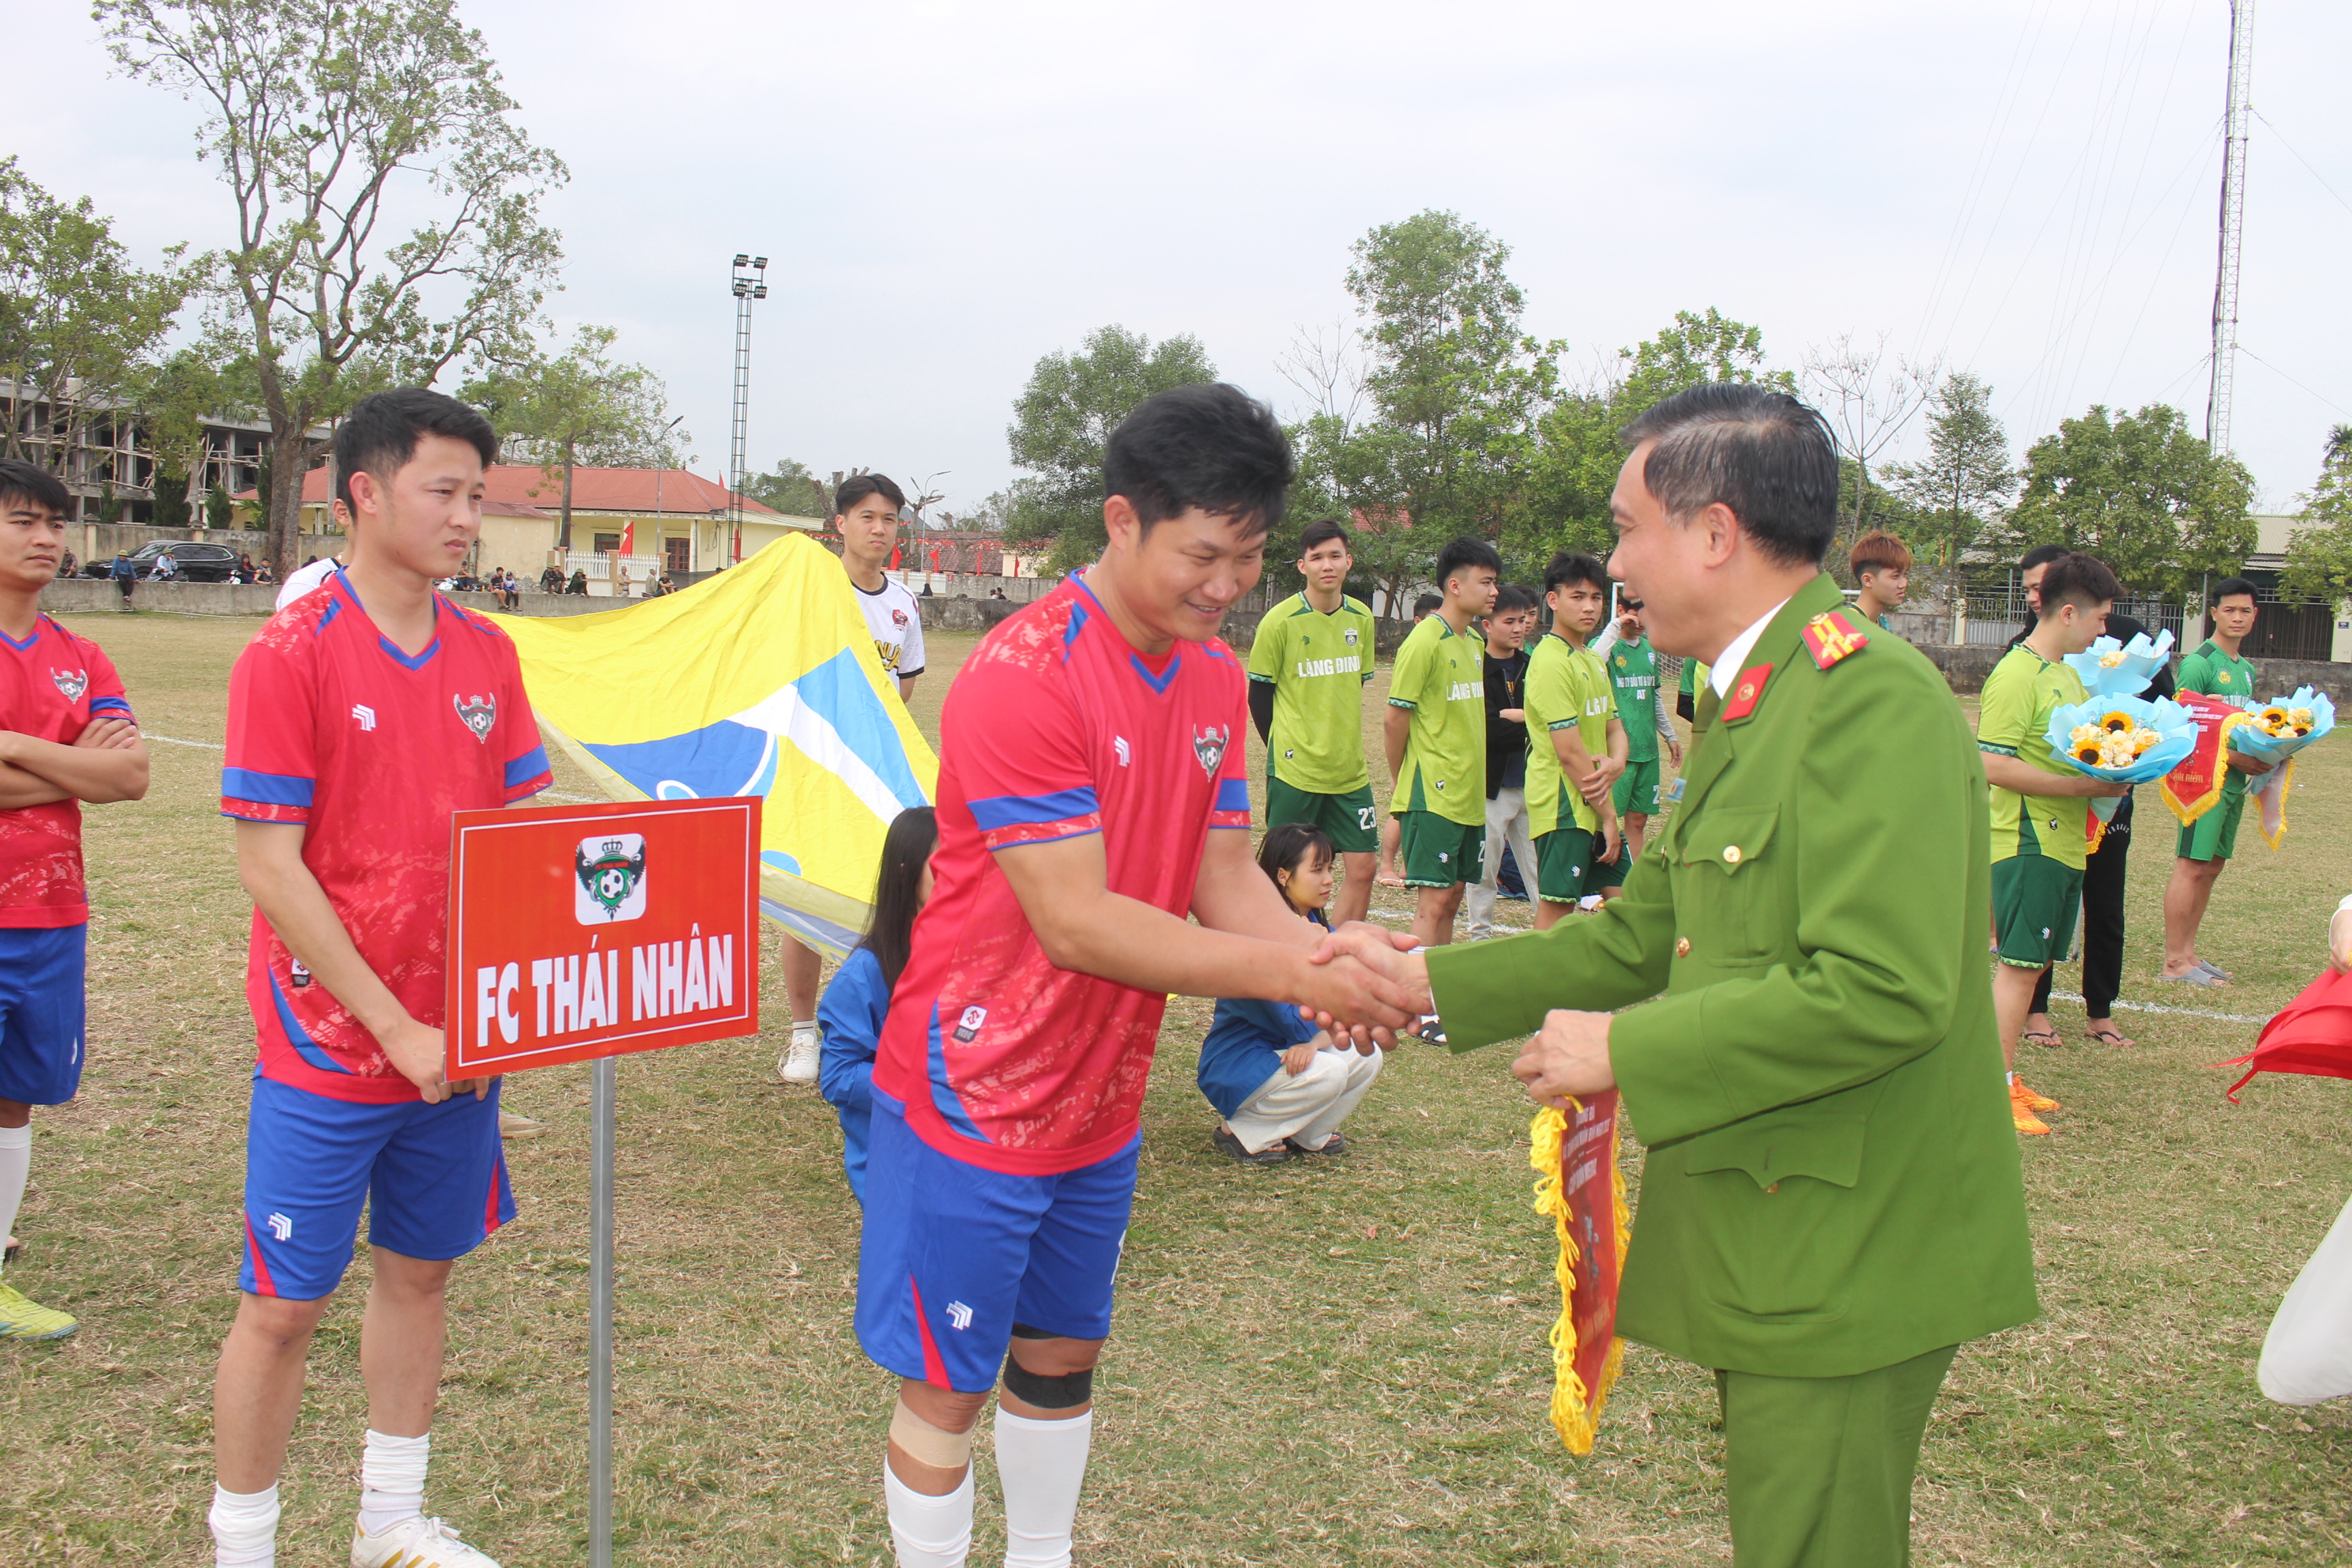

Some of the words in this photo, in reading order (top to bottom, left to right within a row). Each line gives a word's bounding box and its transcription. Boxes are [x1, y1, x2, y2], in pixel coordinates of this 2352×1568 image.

[1298, 657, 1334, 678] LÀNG
[1446, 681, 1471, 701] LÀNG
[1637, 689, 1646, 700] AT
[1358, 806, 1376, 830] 23
[477, 962, 519, 1047] FC
[532, 934, 618, 1037] THÁI
[632, 923, 733, 1022] NHÂN
